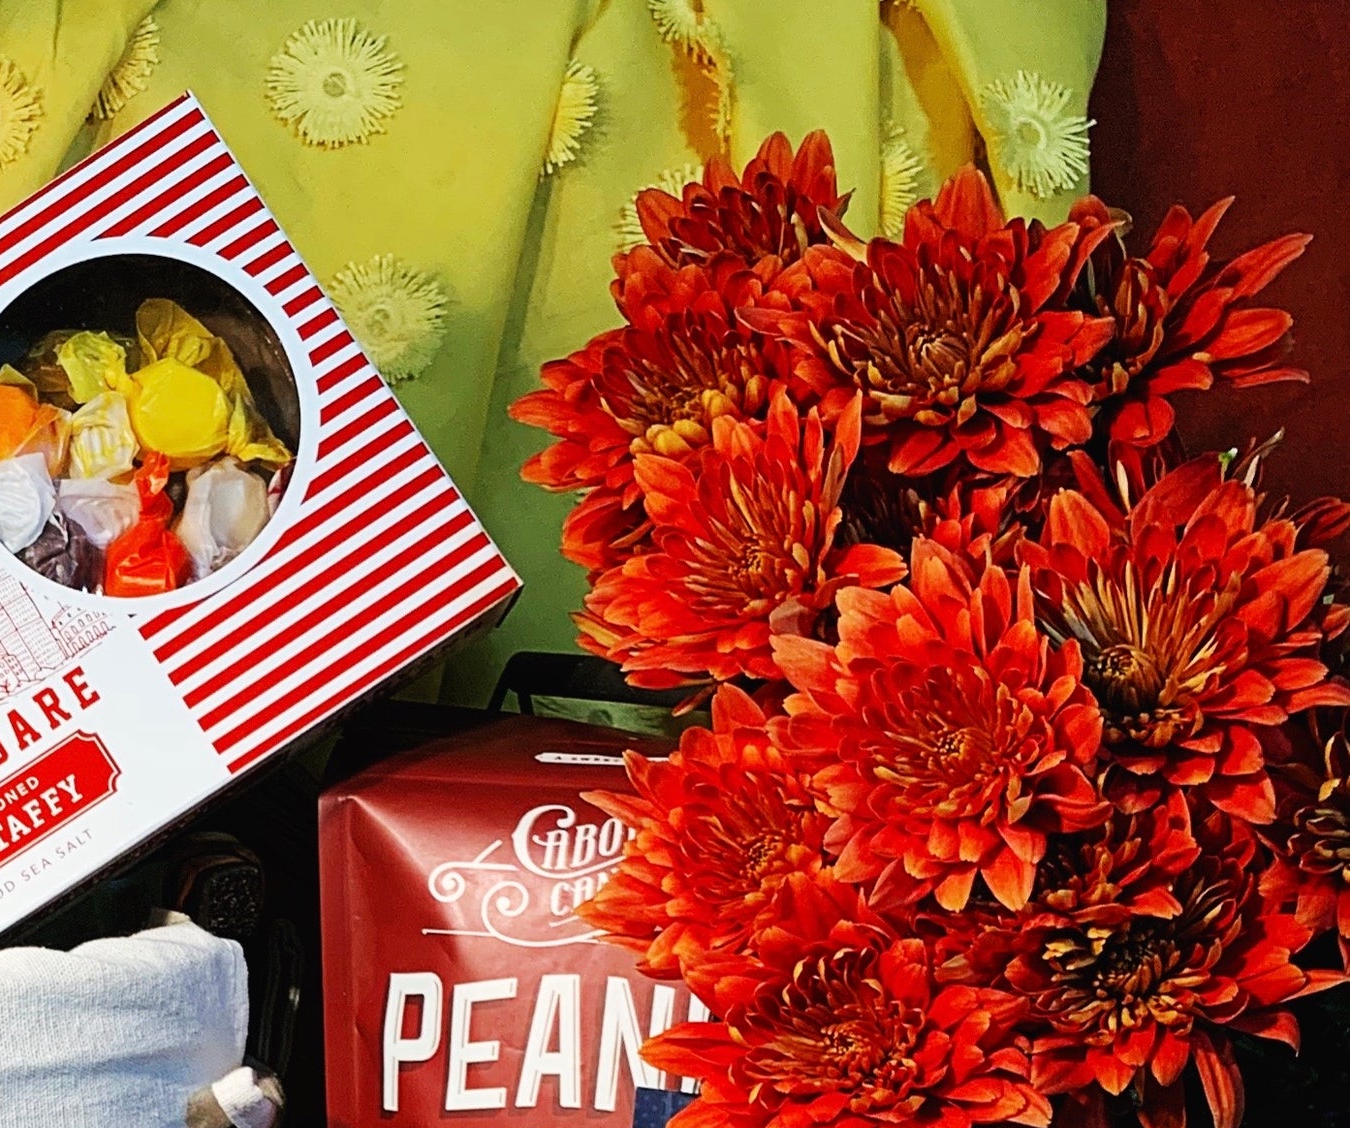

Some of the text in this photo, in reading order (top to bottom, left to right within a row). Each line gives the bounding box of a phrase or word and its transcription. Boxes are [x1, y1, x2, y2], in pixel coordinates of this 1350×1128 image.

[21, 856, 52, 882] SEA
[55, 828, 94, 860] SALT
[511, 804, 636, 879] CABO
[383, 972, 711, 1112] PEAN
